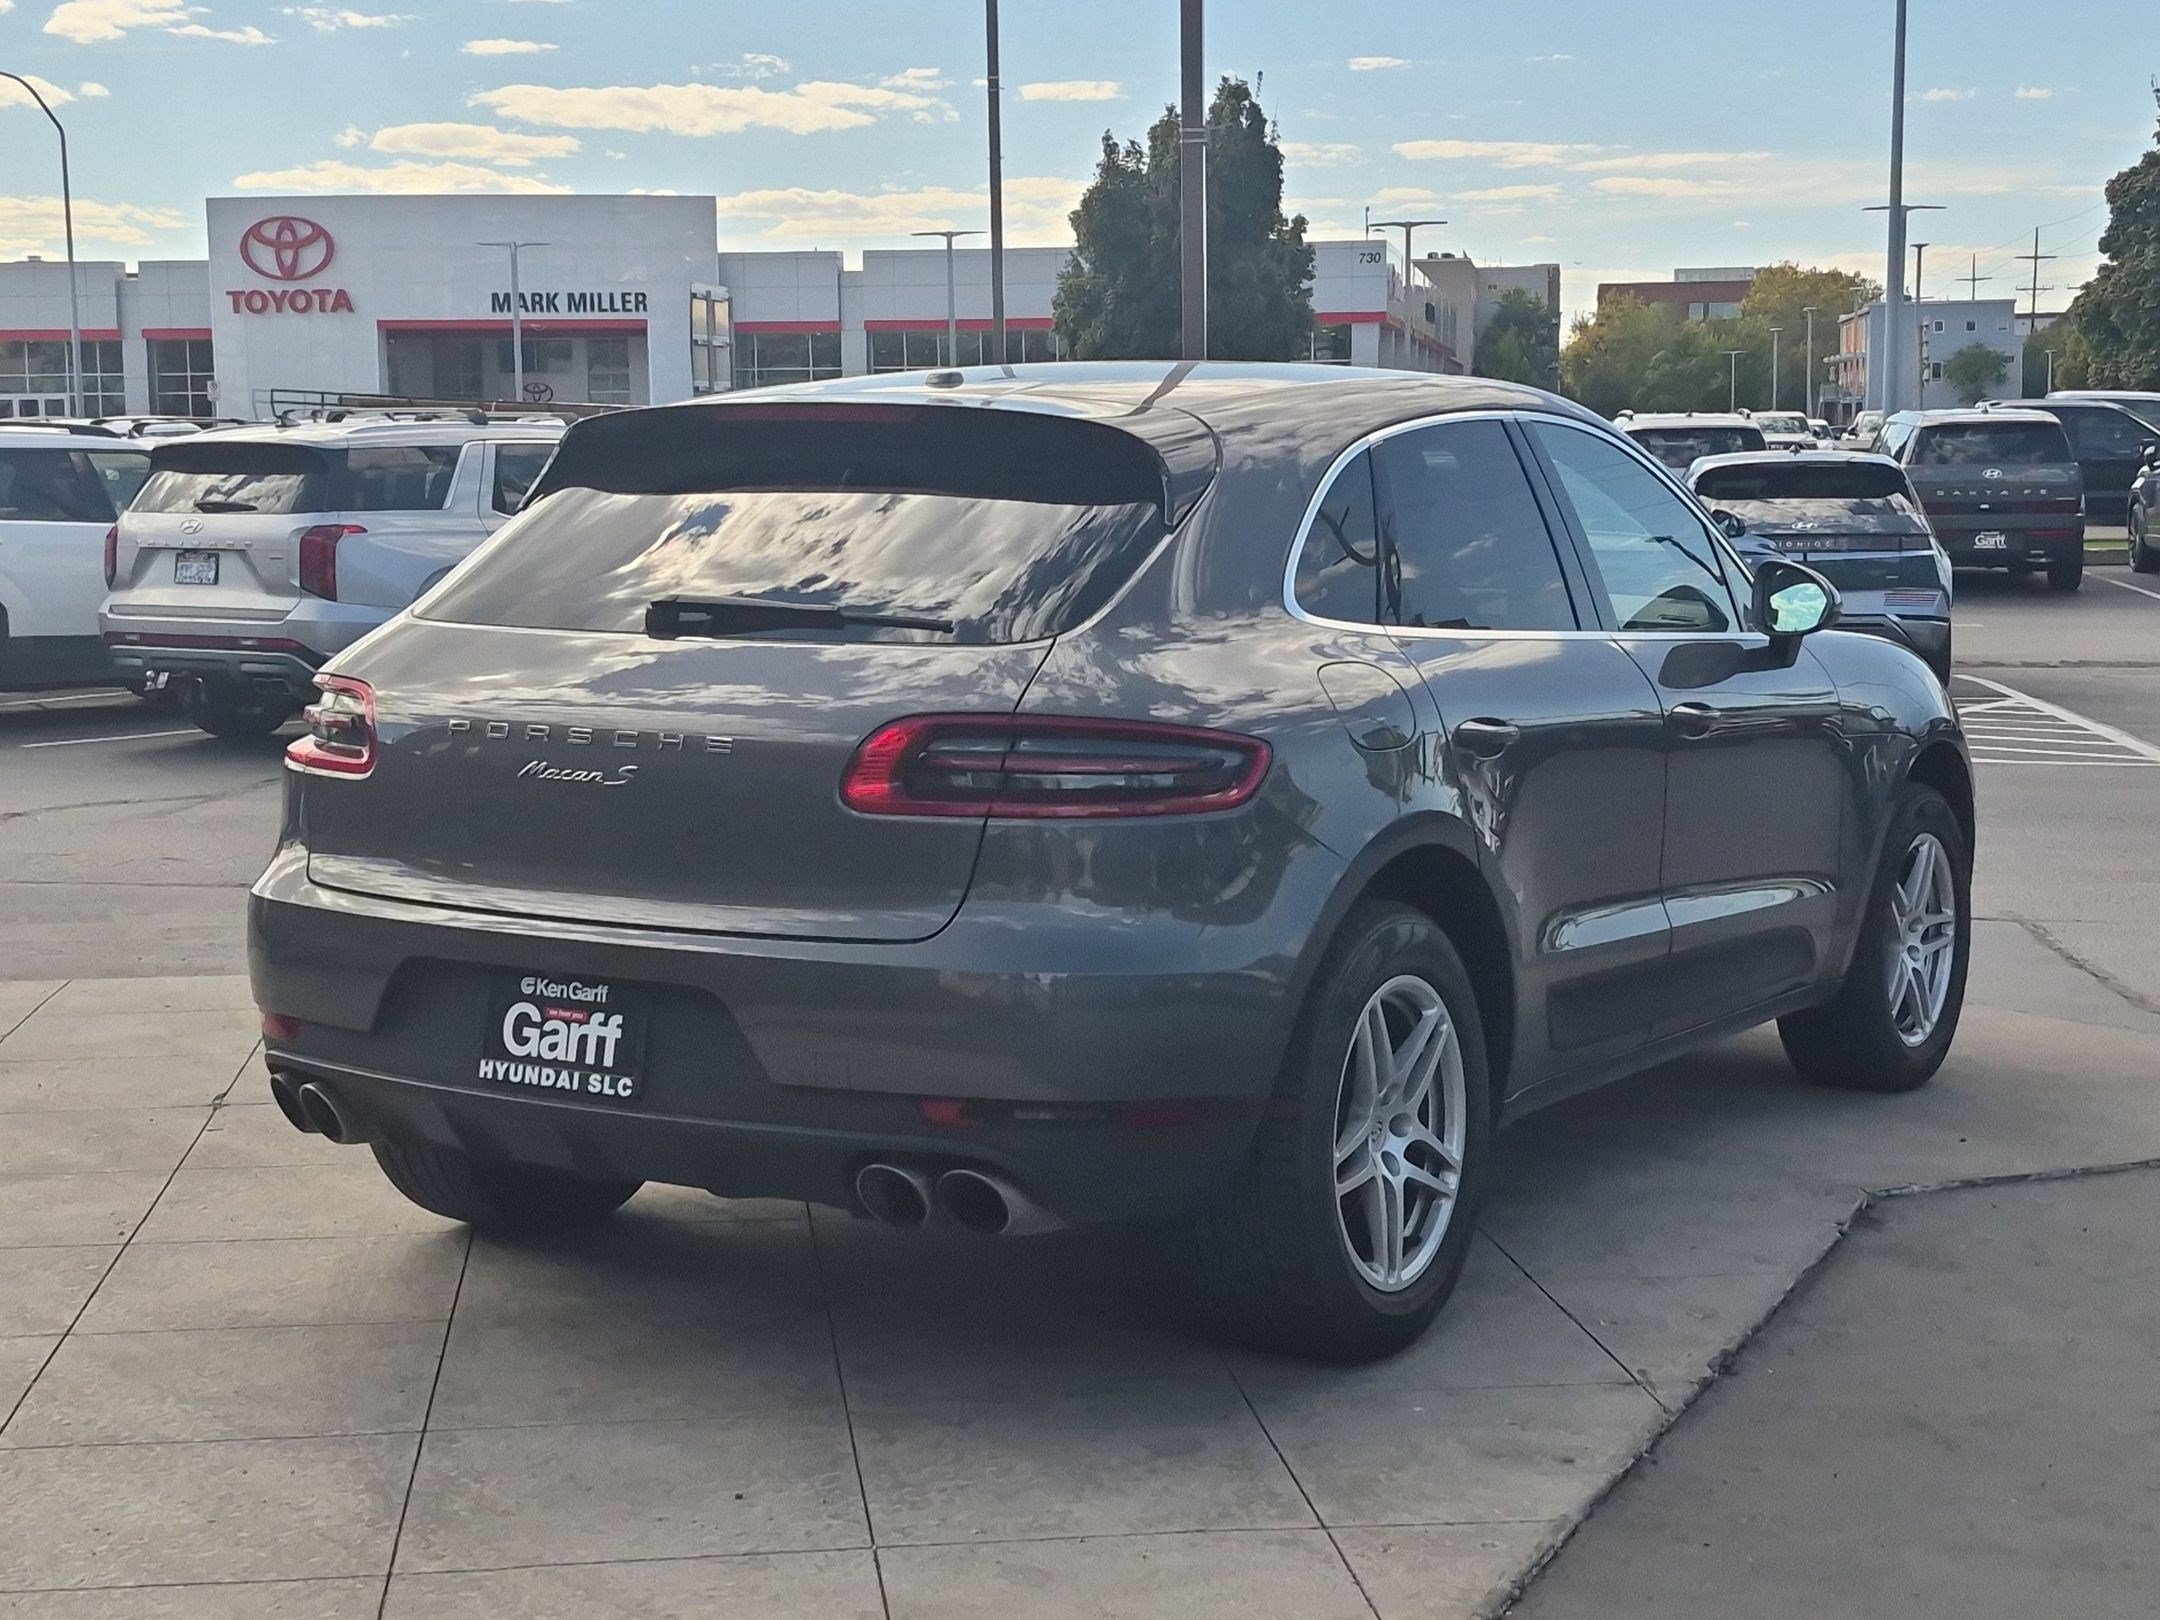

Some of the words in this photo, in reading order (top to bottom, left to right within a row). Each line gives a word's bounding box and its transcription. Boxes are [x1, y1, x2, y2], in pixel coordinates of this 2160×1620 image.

[1359, 252, 1381, 264] 730
[226, 289, 355, 314] TOYOTA
[491, 292, 560, 313] MARK
[567, 292, 648, 313] MILLER
[448, 719, 734, 754] PORSCHE
[517, 760, 604, 783] Macan
[603, 765, 639, 785] S
[536, 978, 568, 999] Ken
[568, 981, 609, 1003] Garff
[503, 1002, 624, 1068] Garff
[478, 1059, 580, 1091] HYUNDAI
[587, 1073, 633, 1097] SLC
